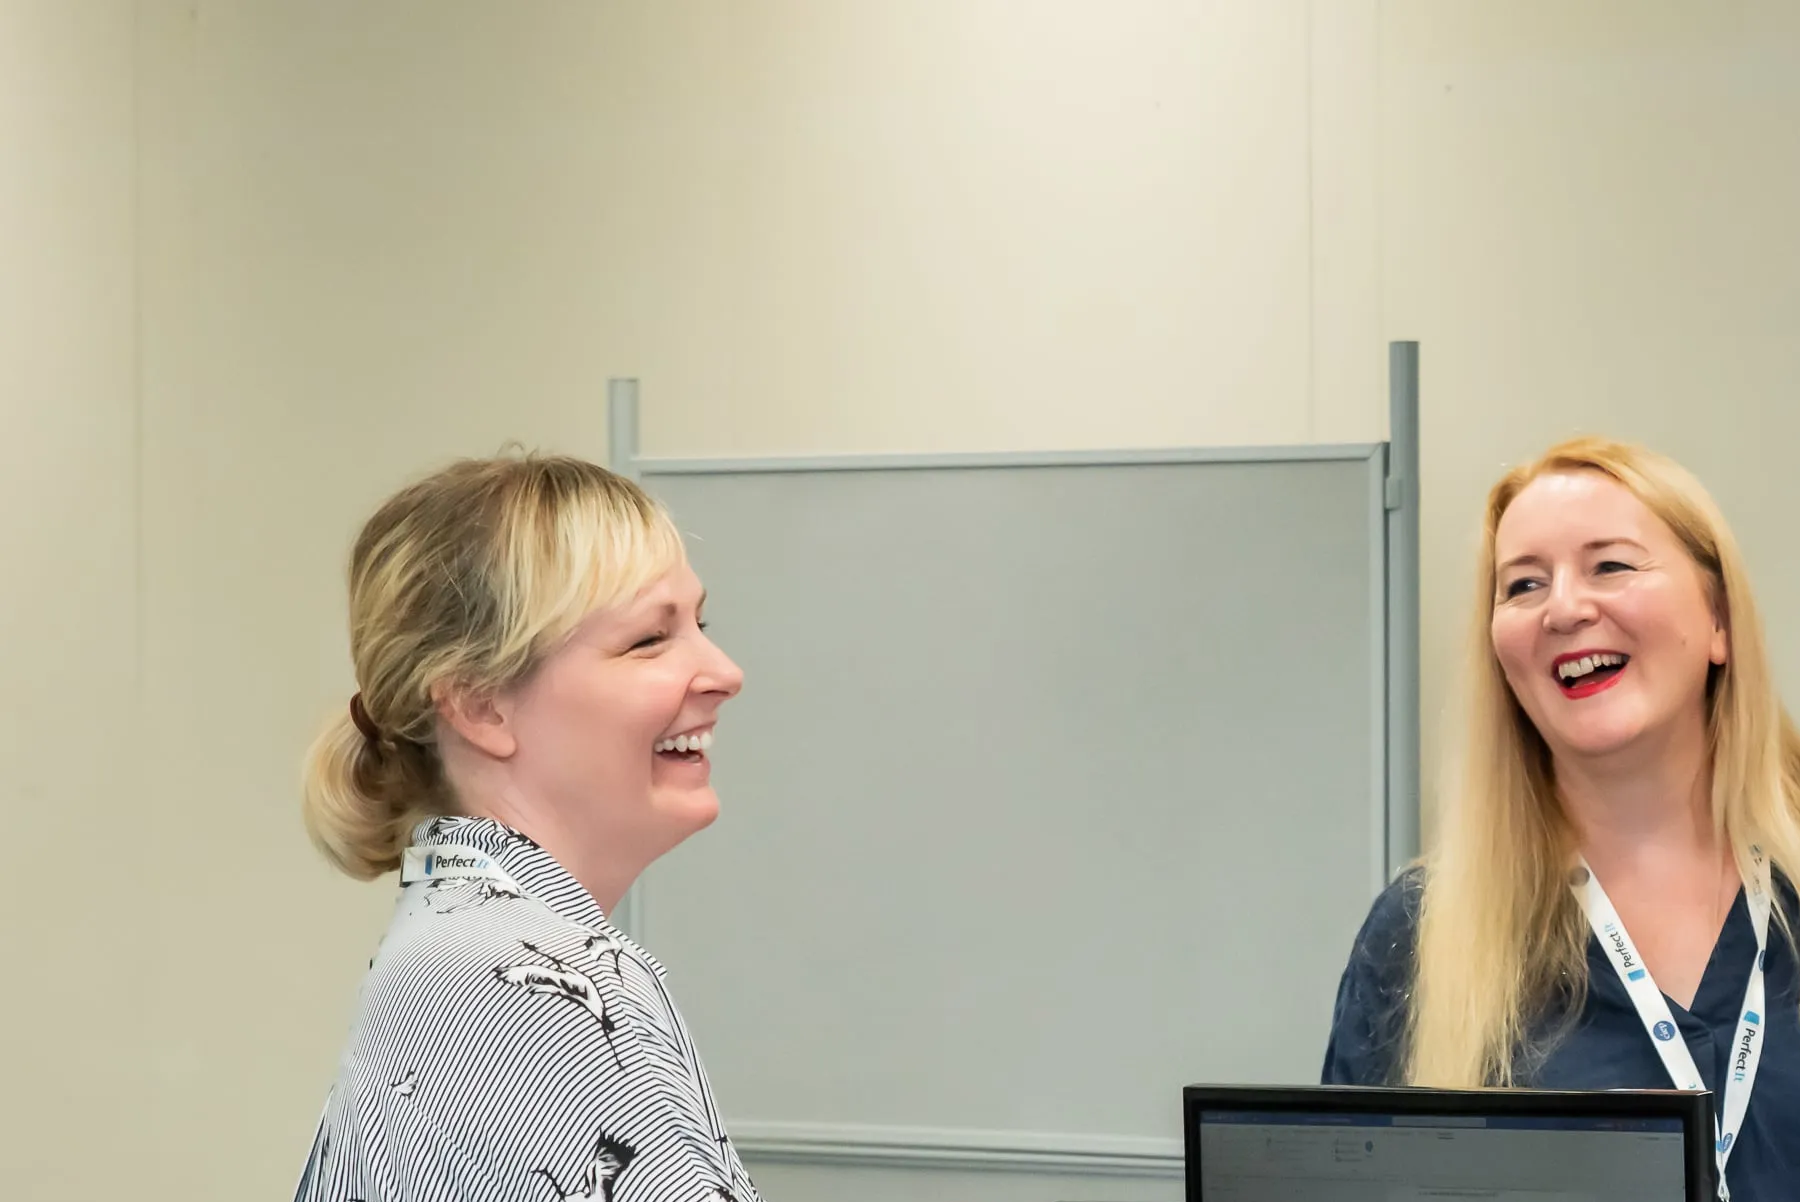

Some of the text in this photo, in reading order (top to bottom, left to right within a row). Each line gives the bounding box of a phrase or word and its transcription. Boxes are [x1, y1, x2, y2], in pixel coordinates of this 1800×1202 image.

[435, 855, 489, 869] PerfectIt
[1604, 923, 1635, 968] PerfectIt
[1734, 1028, 1756, 1083] PerfectIt
